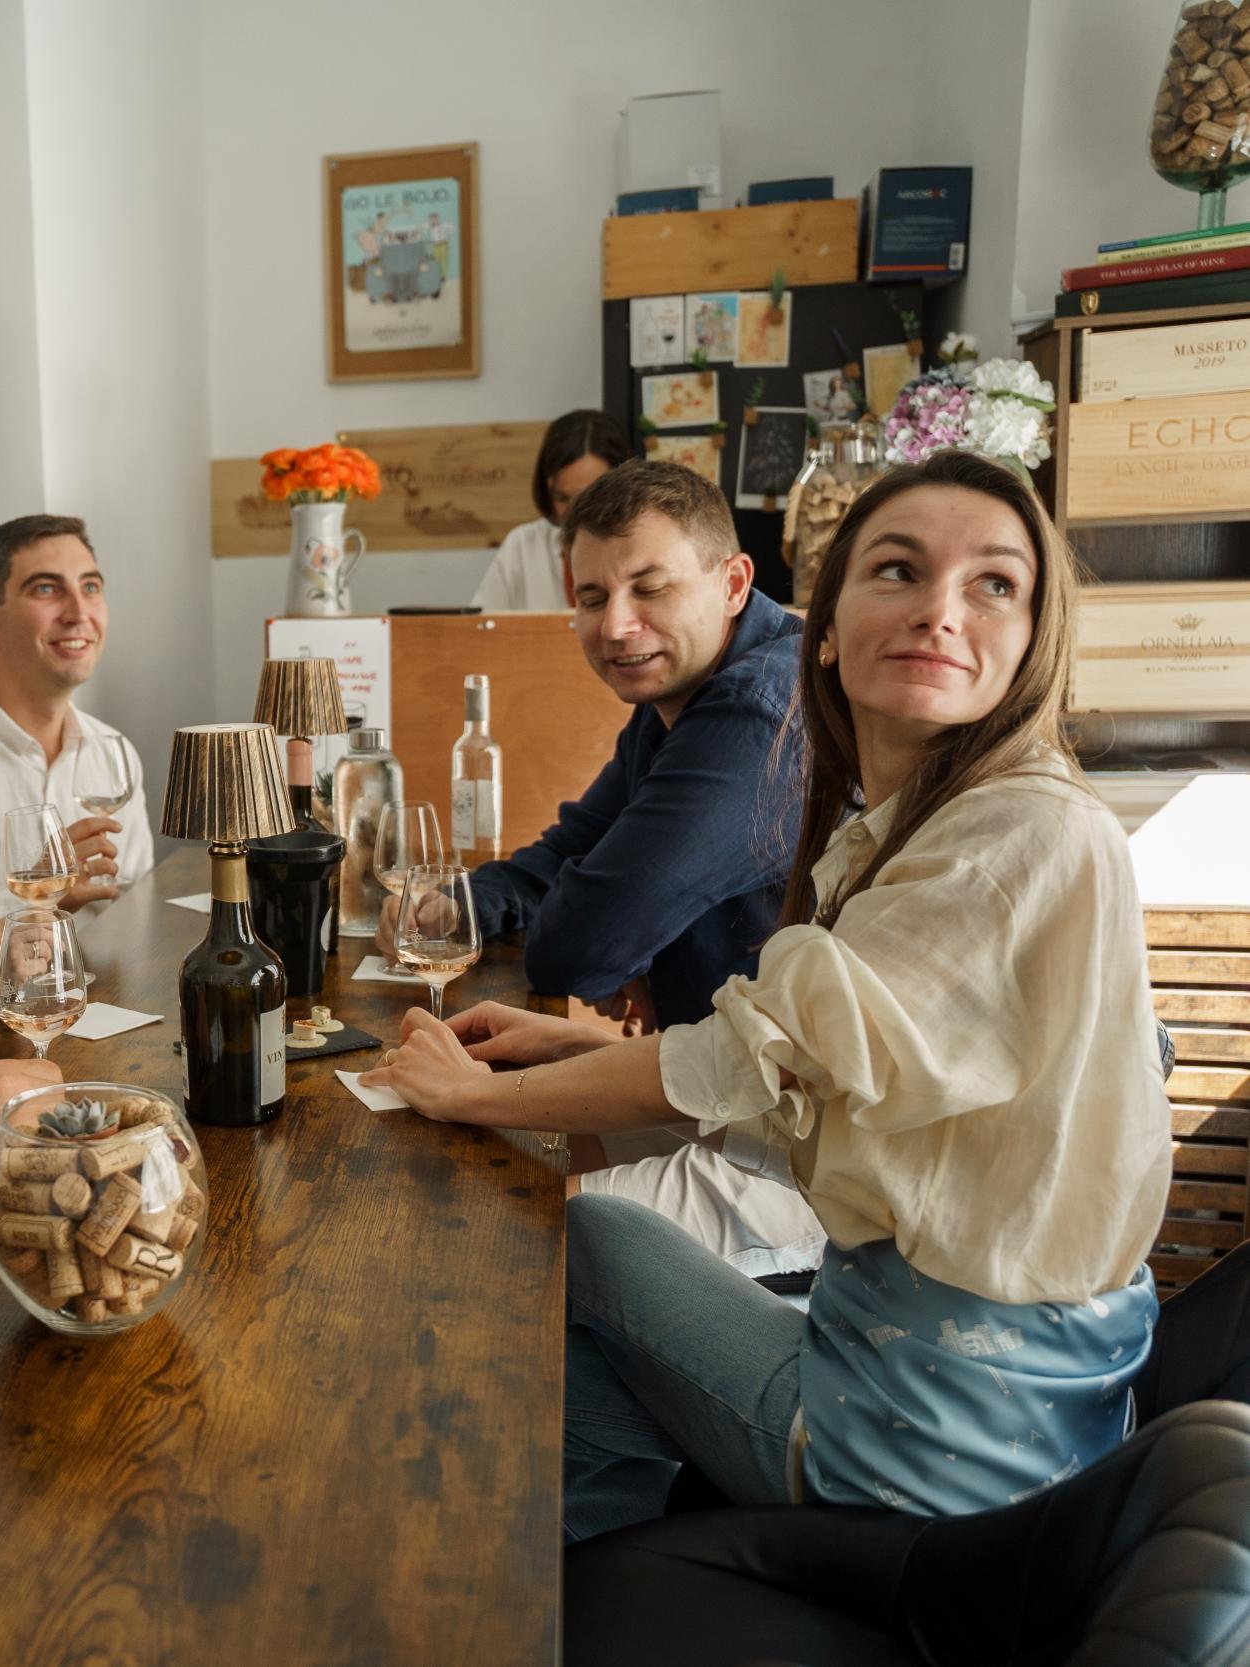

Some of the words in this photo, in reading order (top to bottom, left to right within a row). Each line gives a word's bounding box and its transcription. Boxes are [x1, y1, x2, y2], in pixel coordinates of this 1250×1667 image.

[1100, 271, 1117, 280] THE
[1120, 266, 1153, 277] WORLD
[1185, 260, 1198, 269] OF
[1200, 257, 1226, 267] WINE
[1174, 339, 1248, 357] MASSETO
[1193, 356, 1226, 369] 2019
[1128, 415, 1250, 449] ECHO
[1140, 634, 1236, 650] ORNELLAIA
[132, 1245, 177, 1280] R
